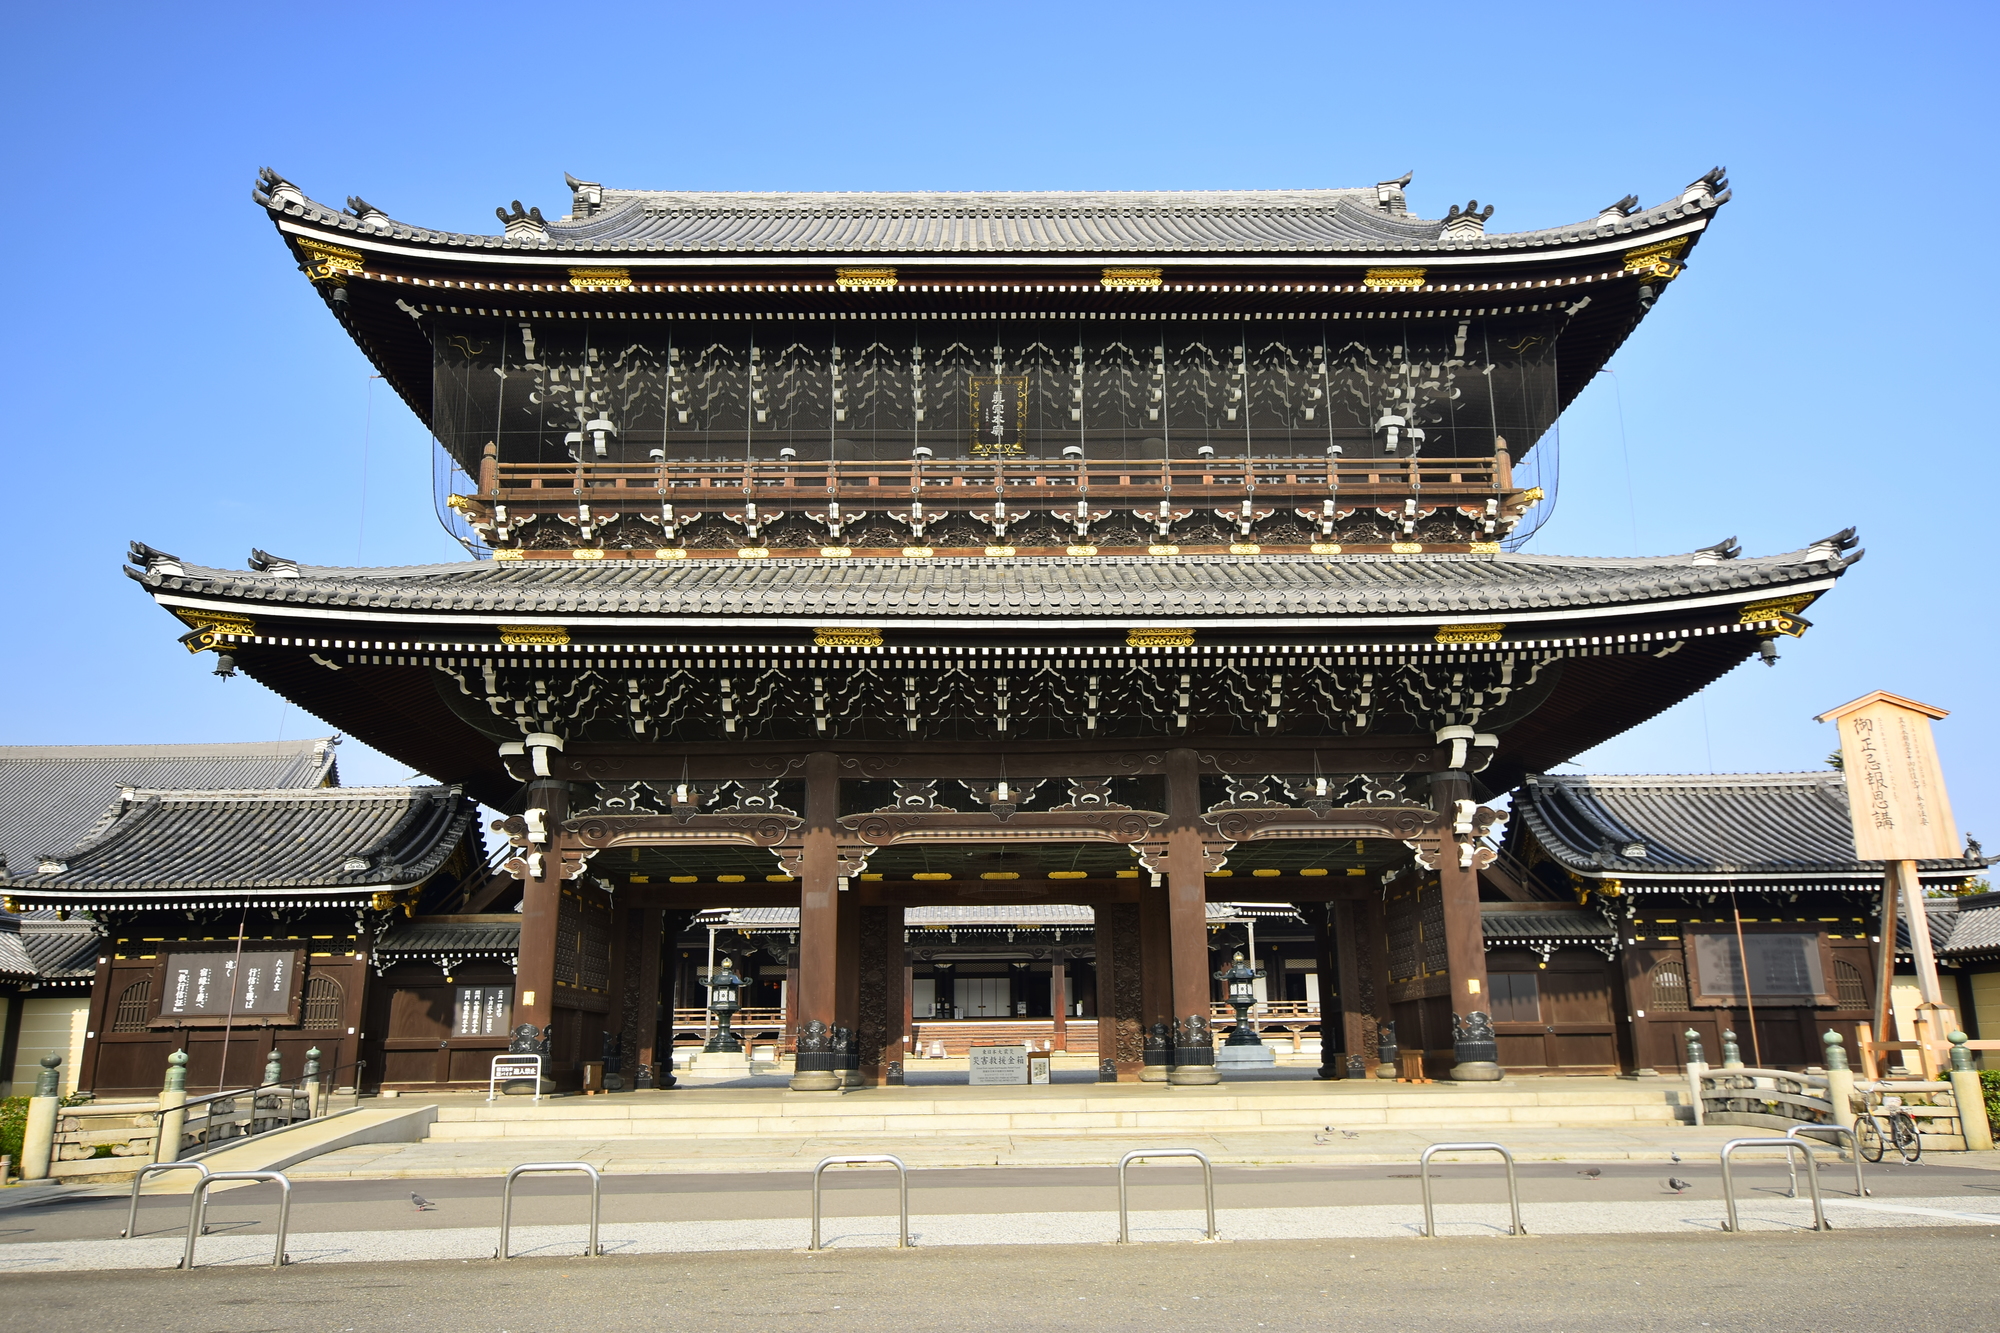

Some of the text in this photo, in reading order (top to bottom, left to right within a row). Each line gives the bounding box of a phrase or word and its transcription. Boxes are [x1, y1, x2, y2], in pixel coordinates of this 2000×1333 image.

[1853, 717, 1896, 830] 御正忌報恩講
[273, 959, 283, 991] たまたま
